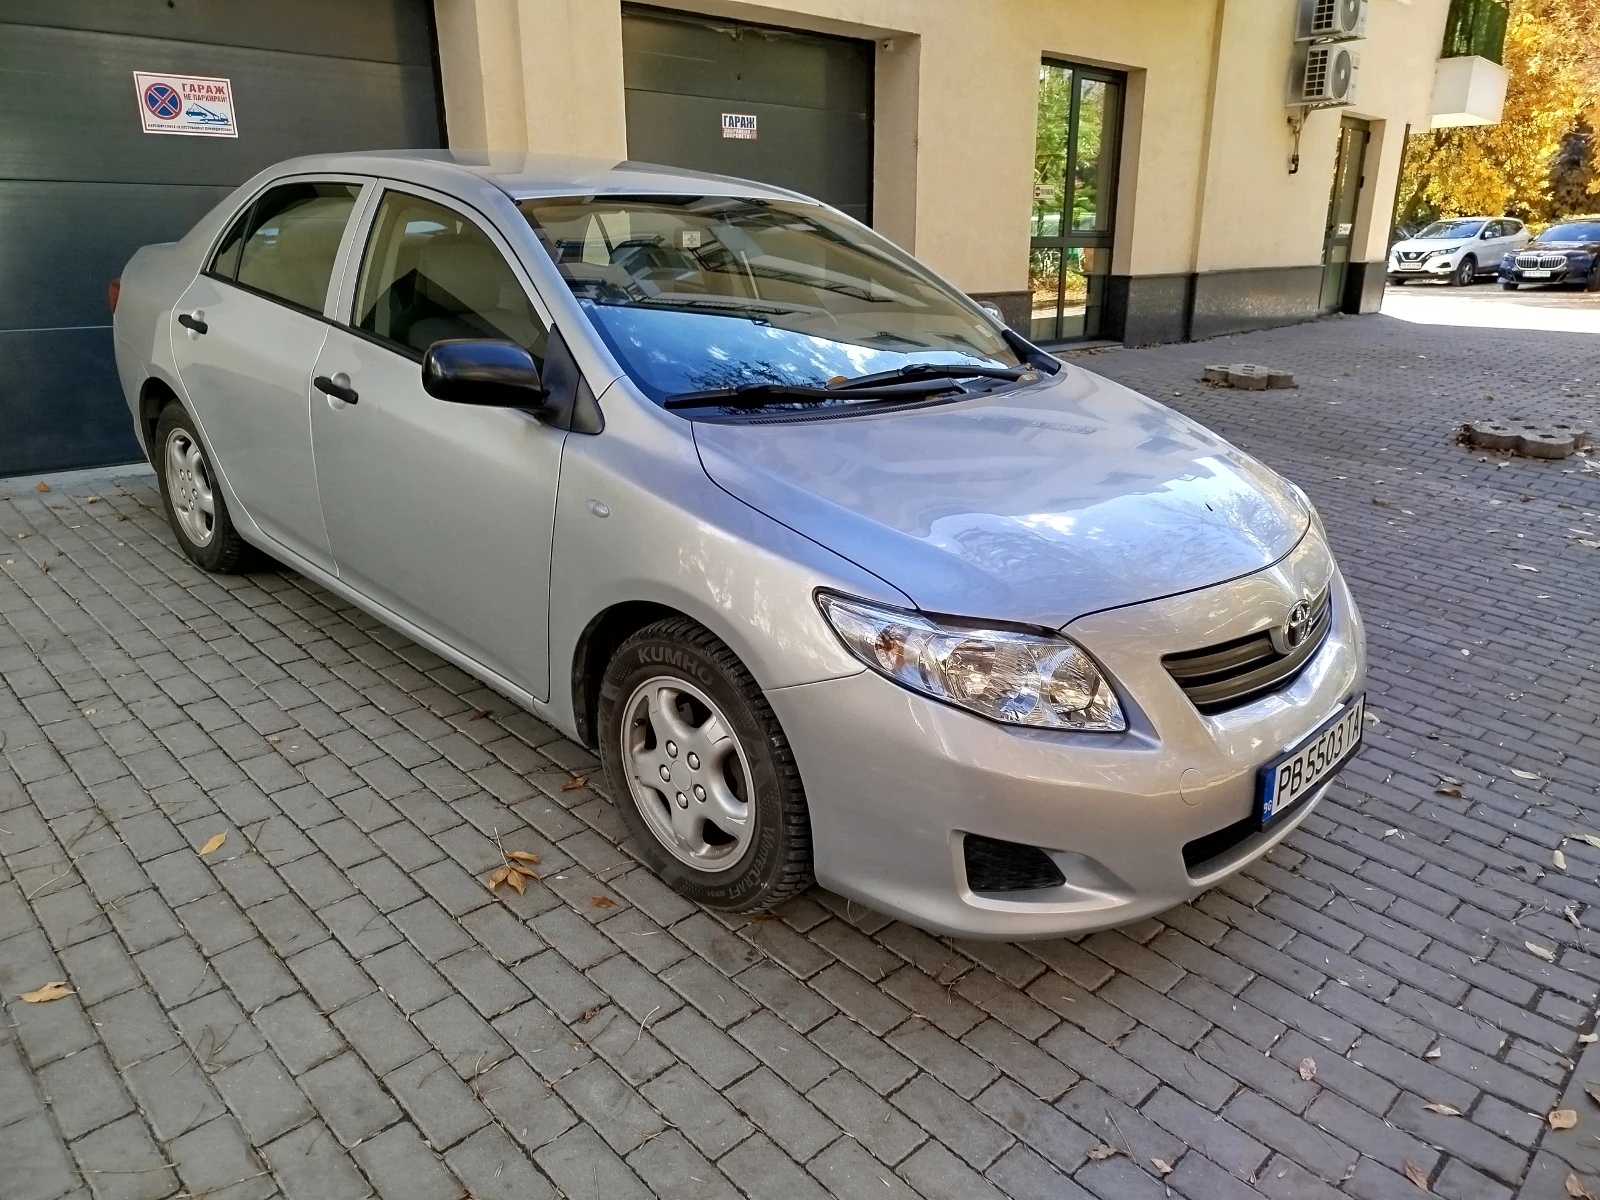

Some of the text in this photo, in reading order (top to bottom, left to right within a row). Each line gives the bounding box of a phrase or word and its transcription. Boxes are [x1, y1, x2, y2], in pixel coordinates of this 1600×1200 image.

[182, 83, 225, 95] ГАРАЖ
[723, 116, 754, 128] ГАРАЖ
[637, 646, 714, 686] KUMHO
[1277, 704, 1360, 806] PB 5503 TA
